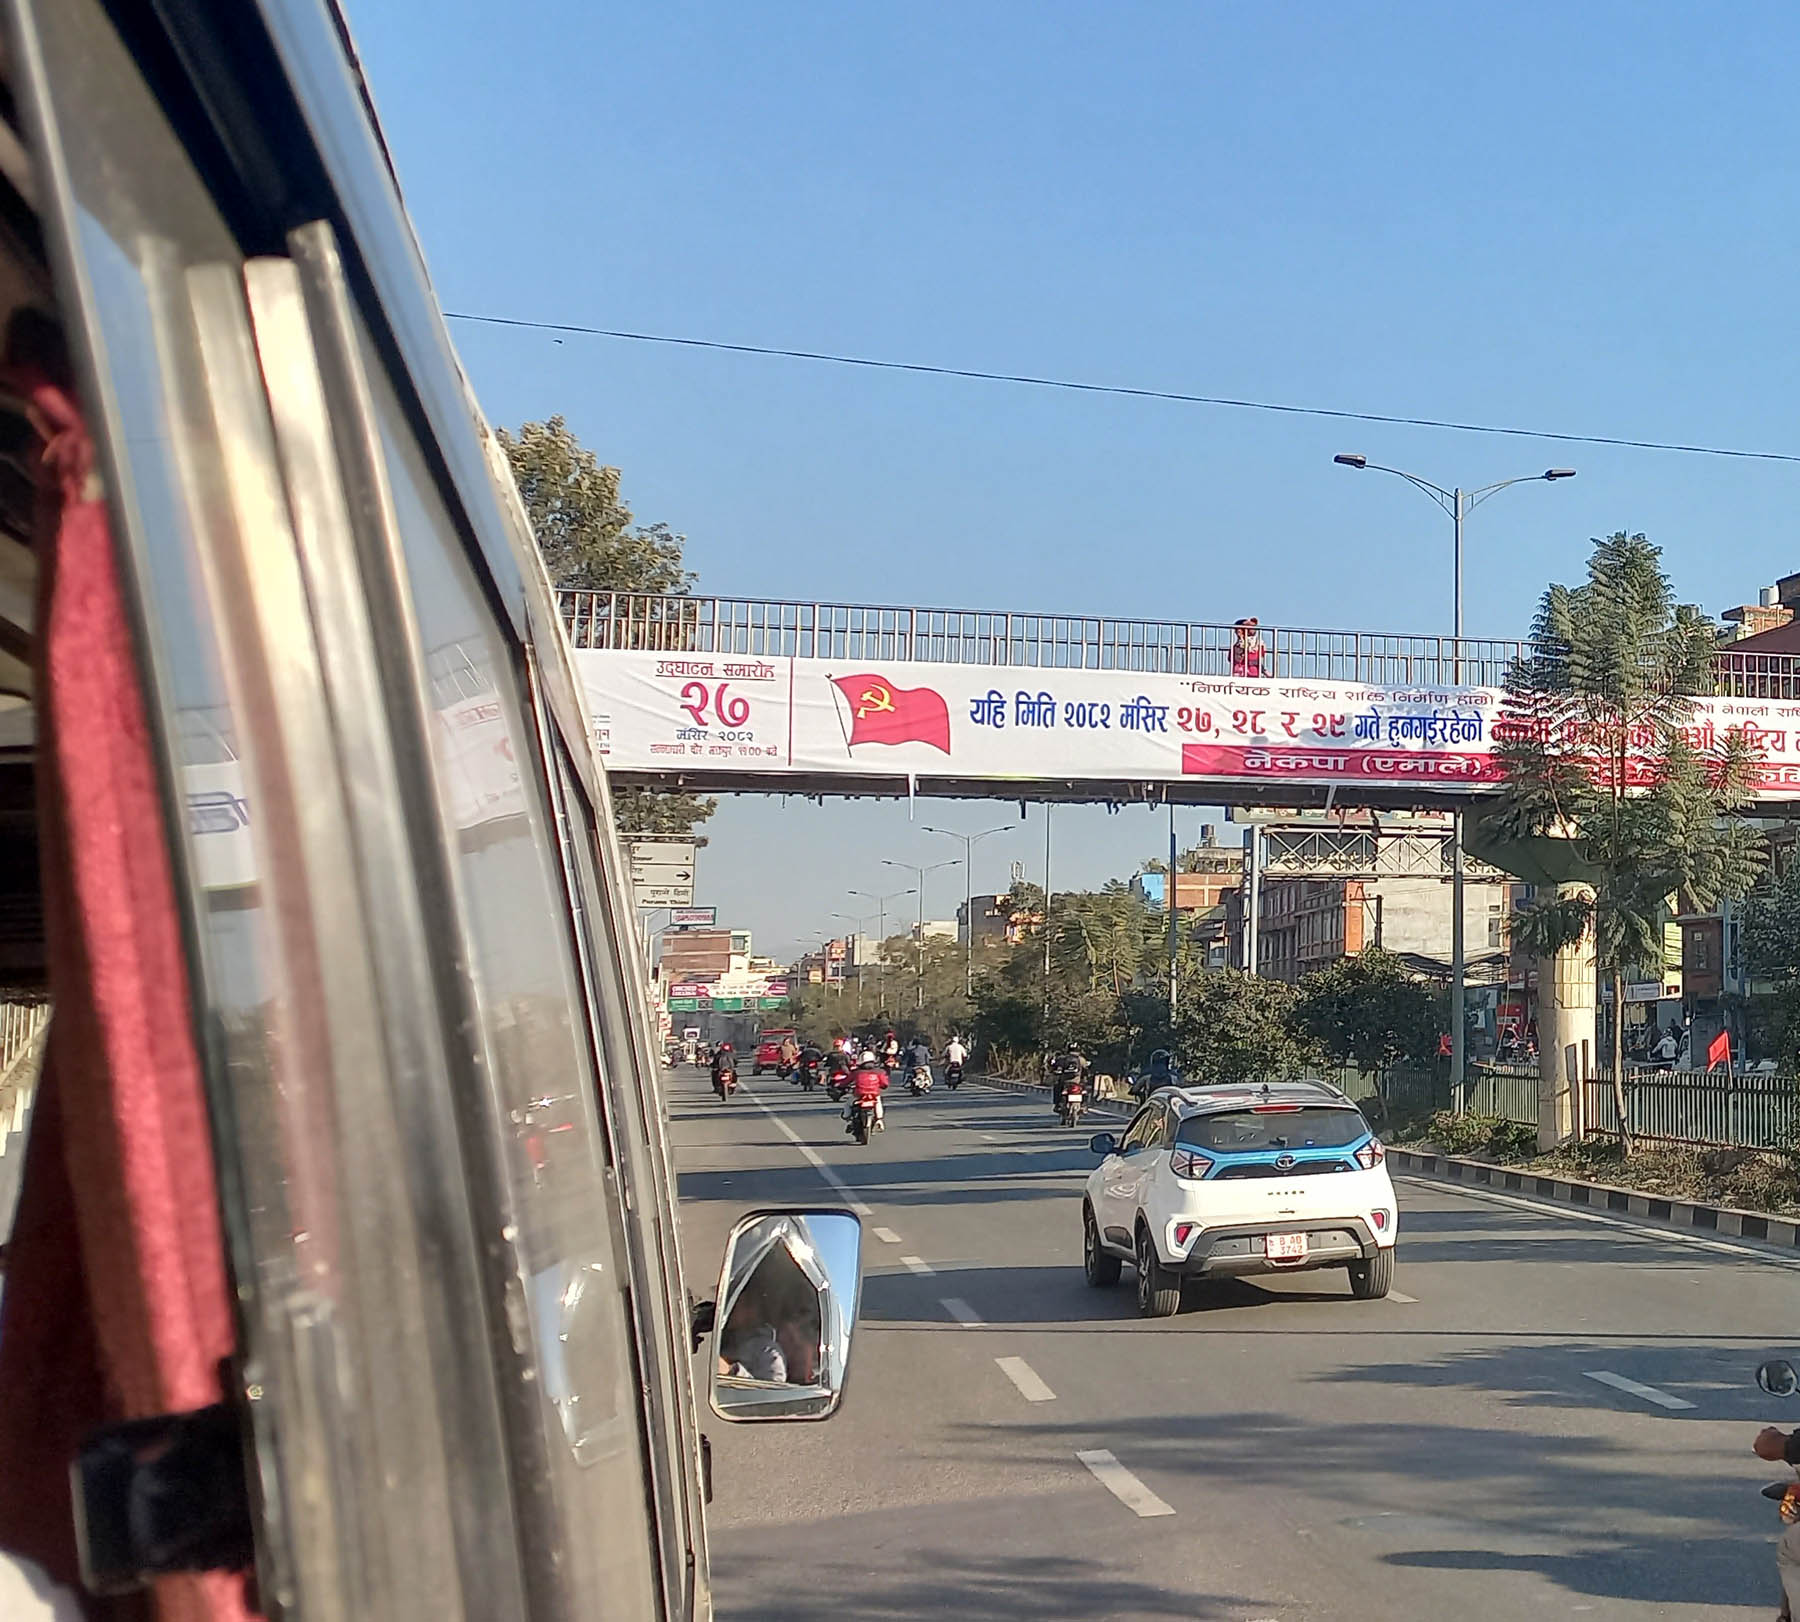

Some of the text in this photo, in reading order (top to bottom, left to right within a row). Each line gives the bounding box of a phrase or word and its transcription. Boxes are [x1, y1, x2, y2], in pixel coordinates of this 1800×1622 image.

[680, 681, 750, 728] २७
[969, 689, 1007, 729] यहि
[1014, 691, 1057, 729] मिति
[1064, 702, 1111, 729] २०८२
[1120, 695, 1170, 733] मंसिर
[1232, 709, 1266, 736] २८
[1281, 711, 1301, 738] र
[1312, 712, 1346, 738] २९
[1354, 707, 1380, 740] गते
[718, 731, 754, 742] २०८२
[1243, 750, 1349, 772] नेकपा
